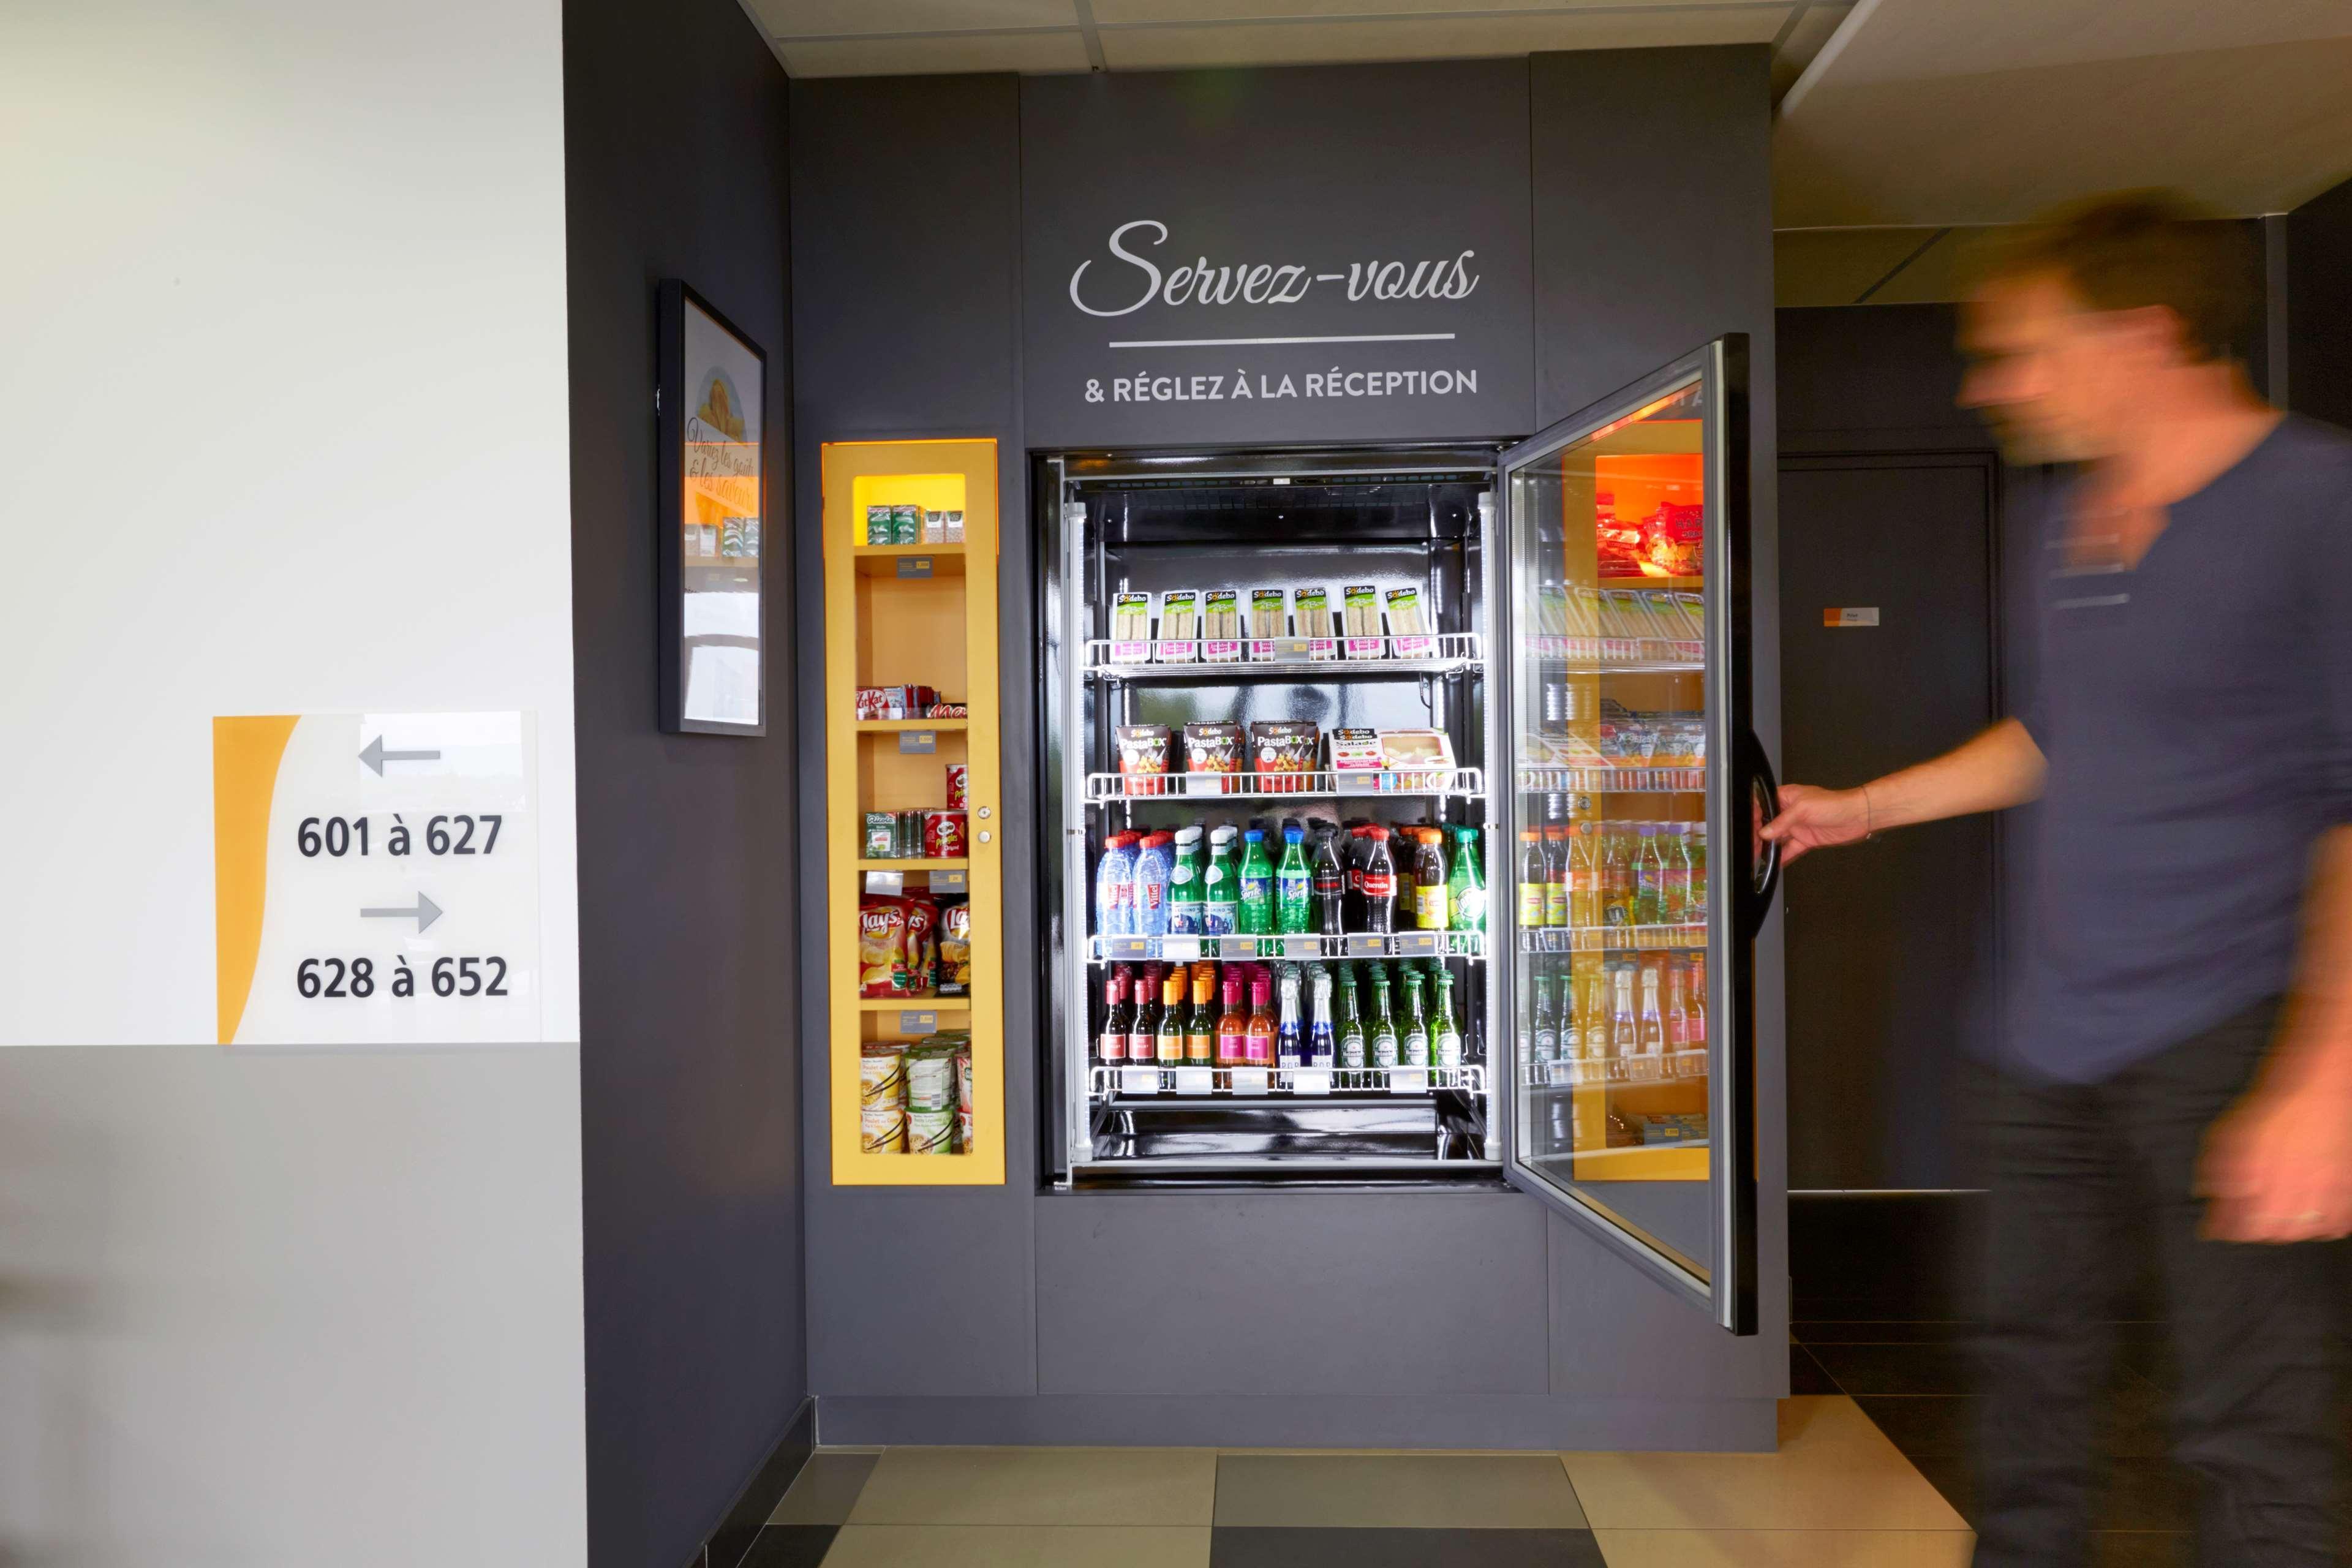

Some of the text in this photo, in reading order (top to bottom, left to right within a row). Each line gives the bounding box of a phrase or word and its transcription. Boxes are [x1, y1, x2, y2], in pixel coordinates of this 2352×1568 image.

[1069, 220, 1480, 317] Servez-vous
[1085, 366, 1477, 402] & RÉGLEZ À LA RÉCEPTION
[1676, 519, 1703, 529] HAR
[927, 704, 967, 718] Ma
[298, 813, 502, 858] 601 à 627
[1287, 888, 1309, 901] Spri
[297, 955, 508, 998] 628 à 652
